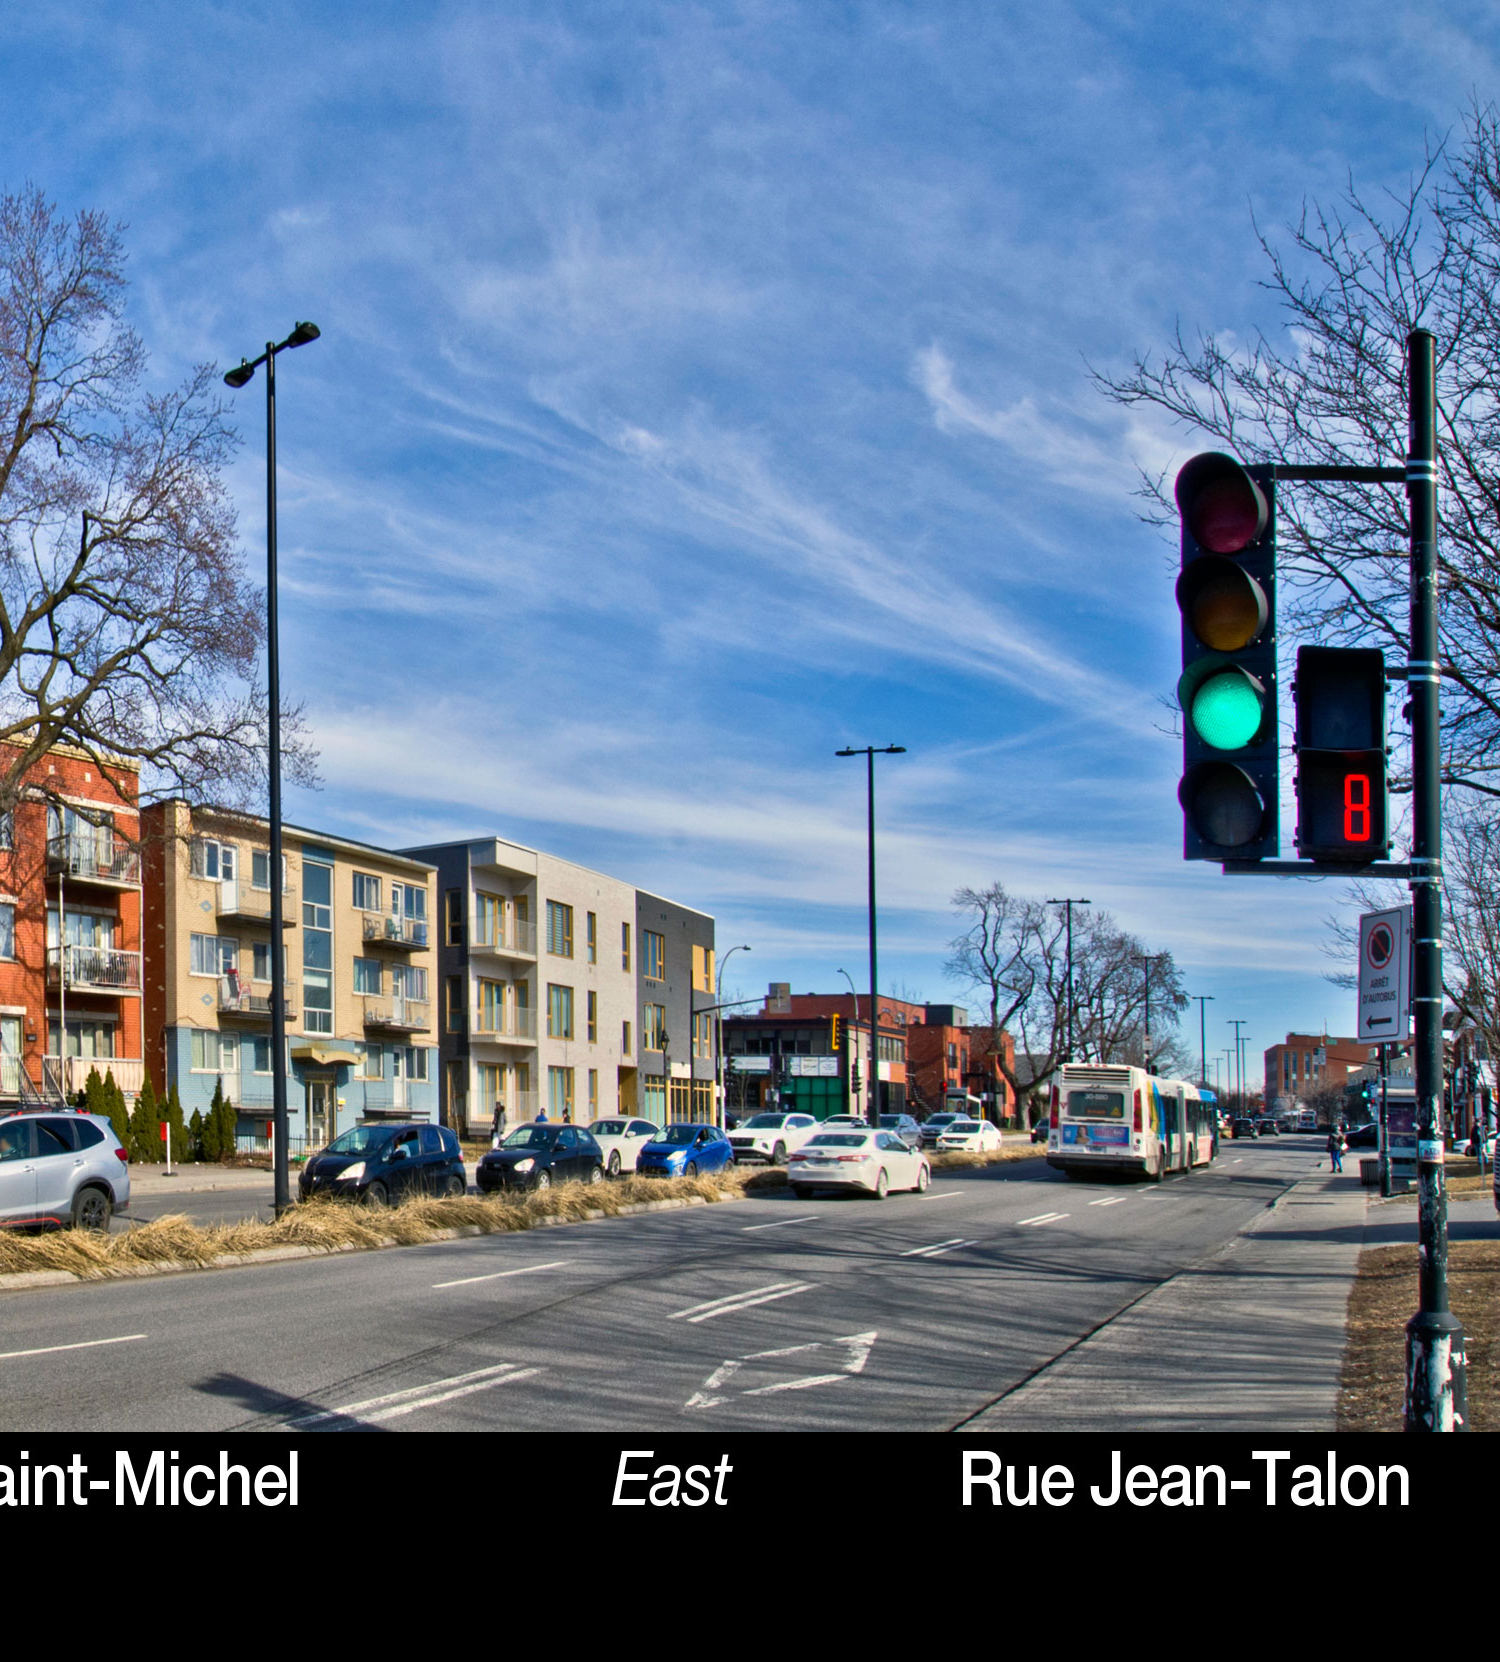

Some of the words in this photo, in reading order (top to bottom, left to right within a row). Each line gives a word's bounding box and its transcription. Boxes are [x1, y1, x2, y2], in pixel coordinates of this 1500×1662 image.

[1343, 773, 1371, 842] 8
[1370, 975, 1389, 989] ARRÊT
[1362, 990, 1397, 1005] D'AUTOBUS
